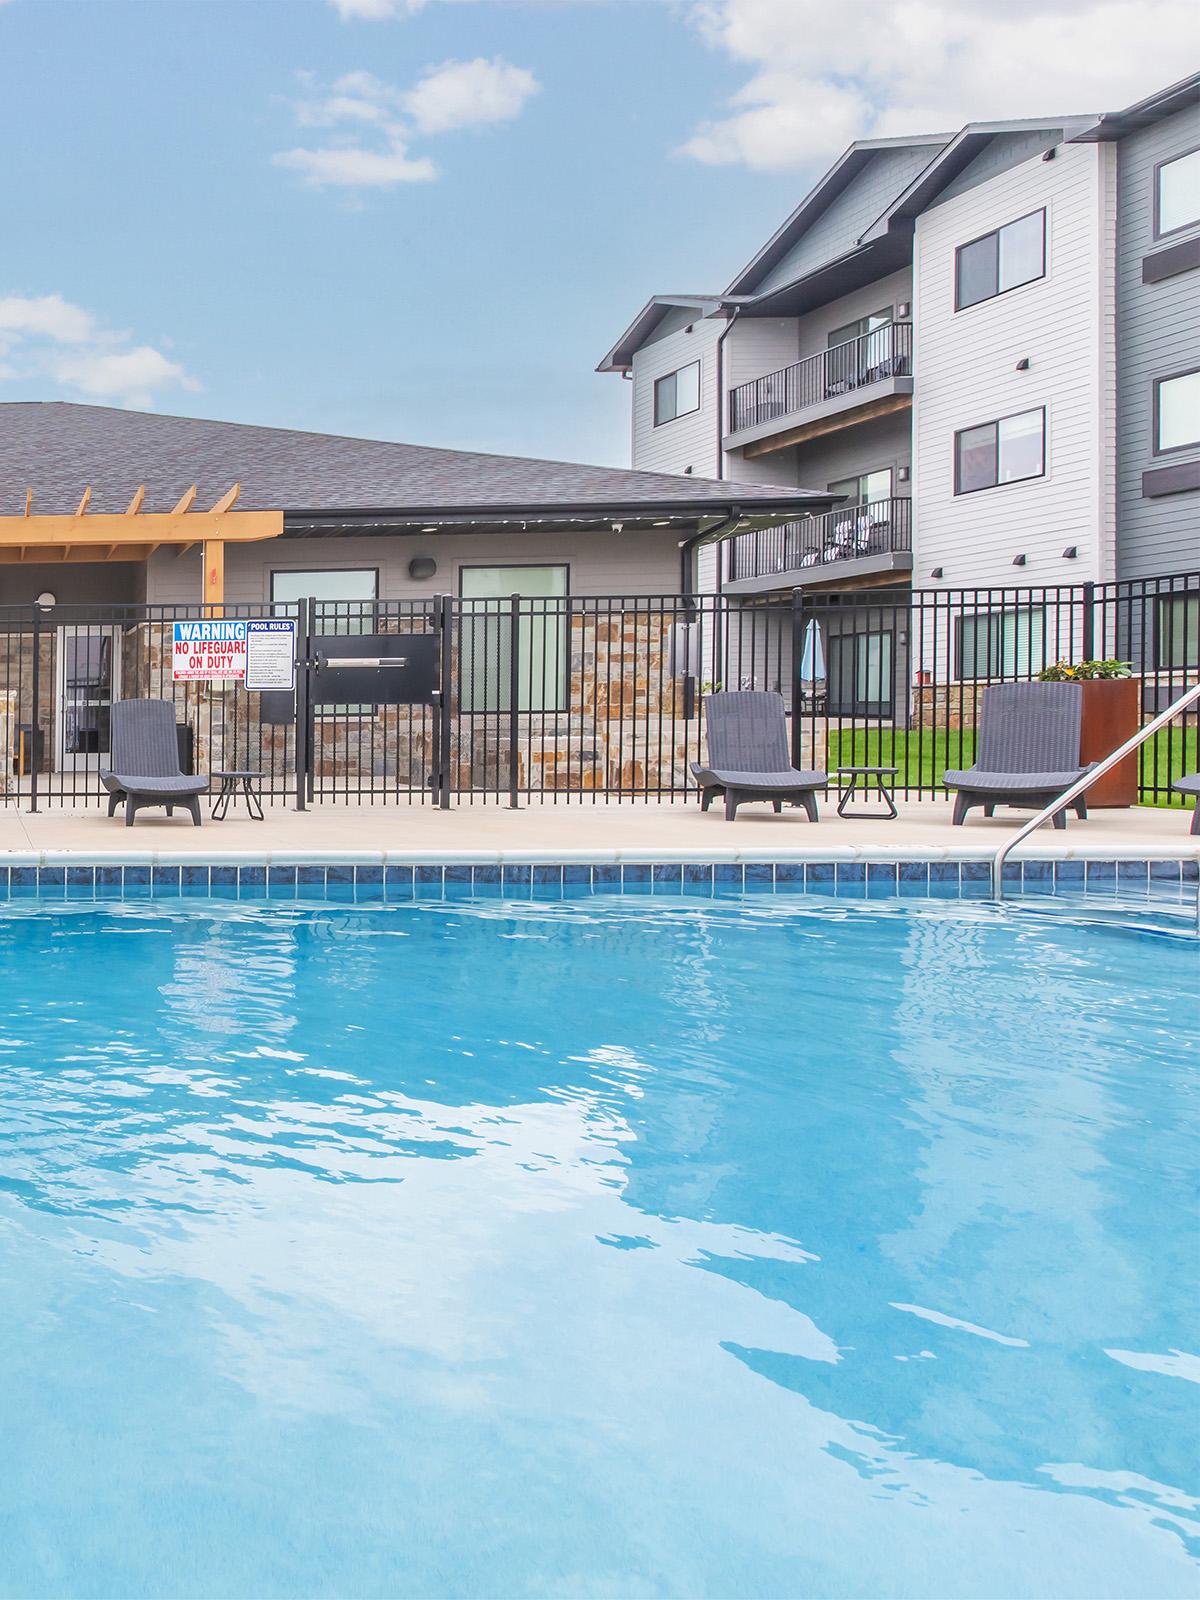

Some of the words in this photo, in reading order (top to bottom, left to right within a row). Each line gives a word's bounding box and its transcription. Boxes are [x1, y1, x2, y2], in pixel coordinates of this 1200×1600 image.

[180, 623, 245, 640] WARNING
[175, 641, 189, 654] NO
[189, 656, 203, 669] ON
[207, 656, 233, 669] DUTY
